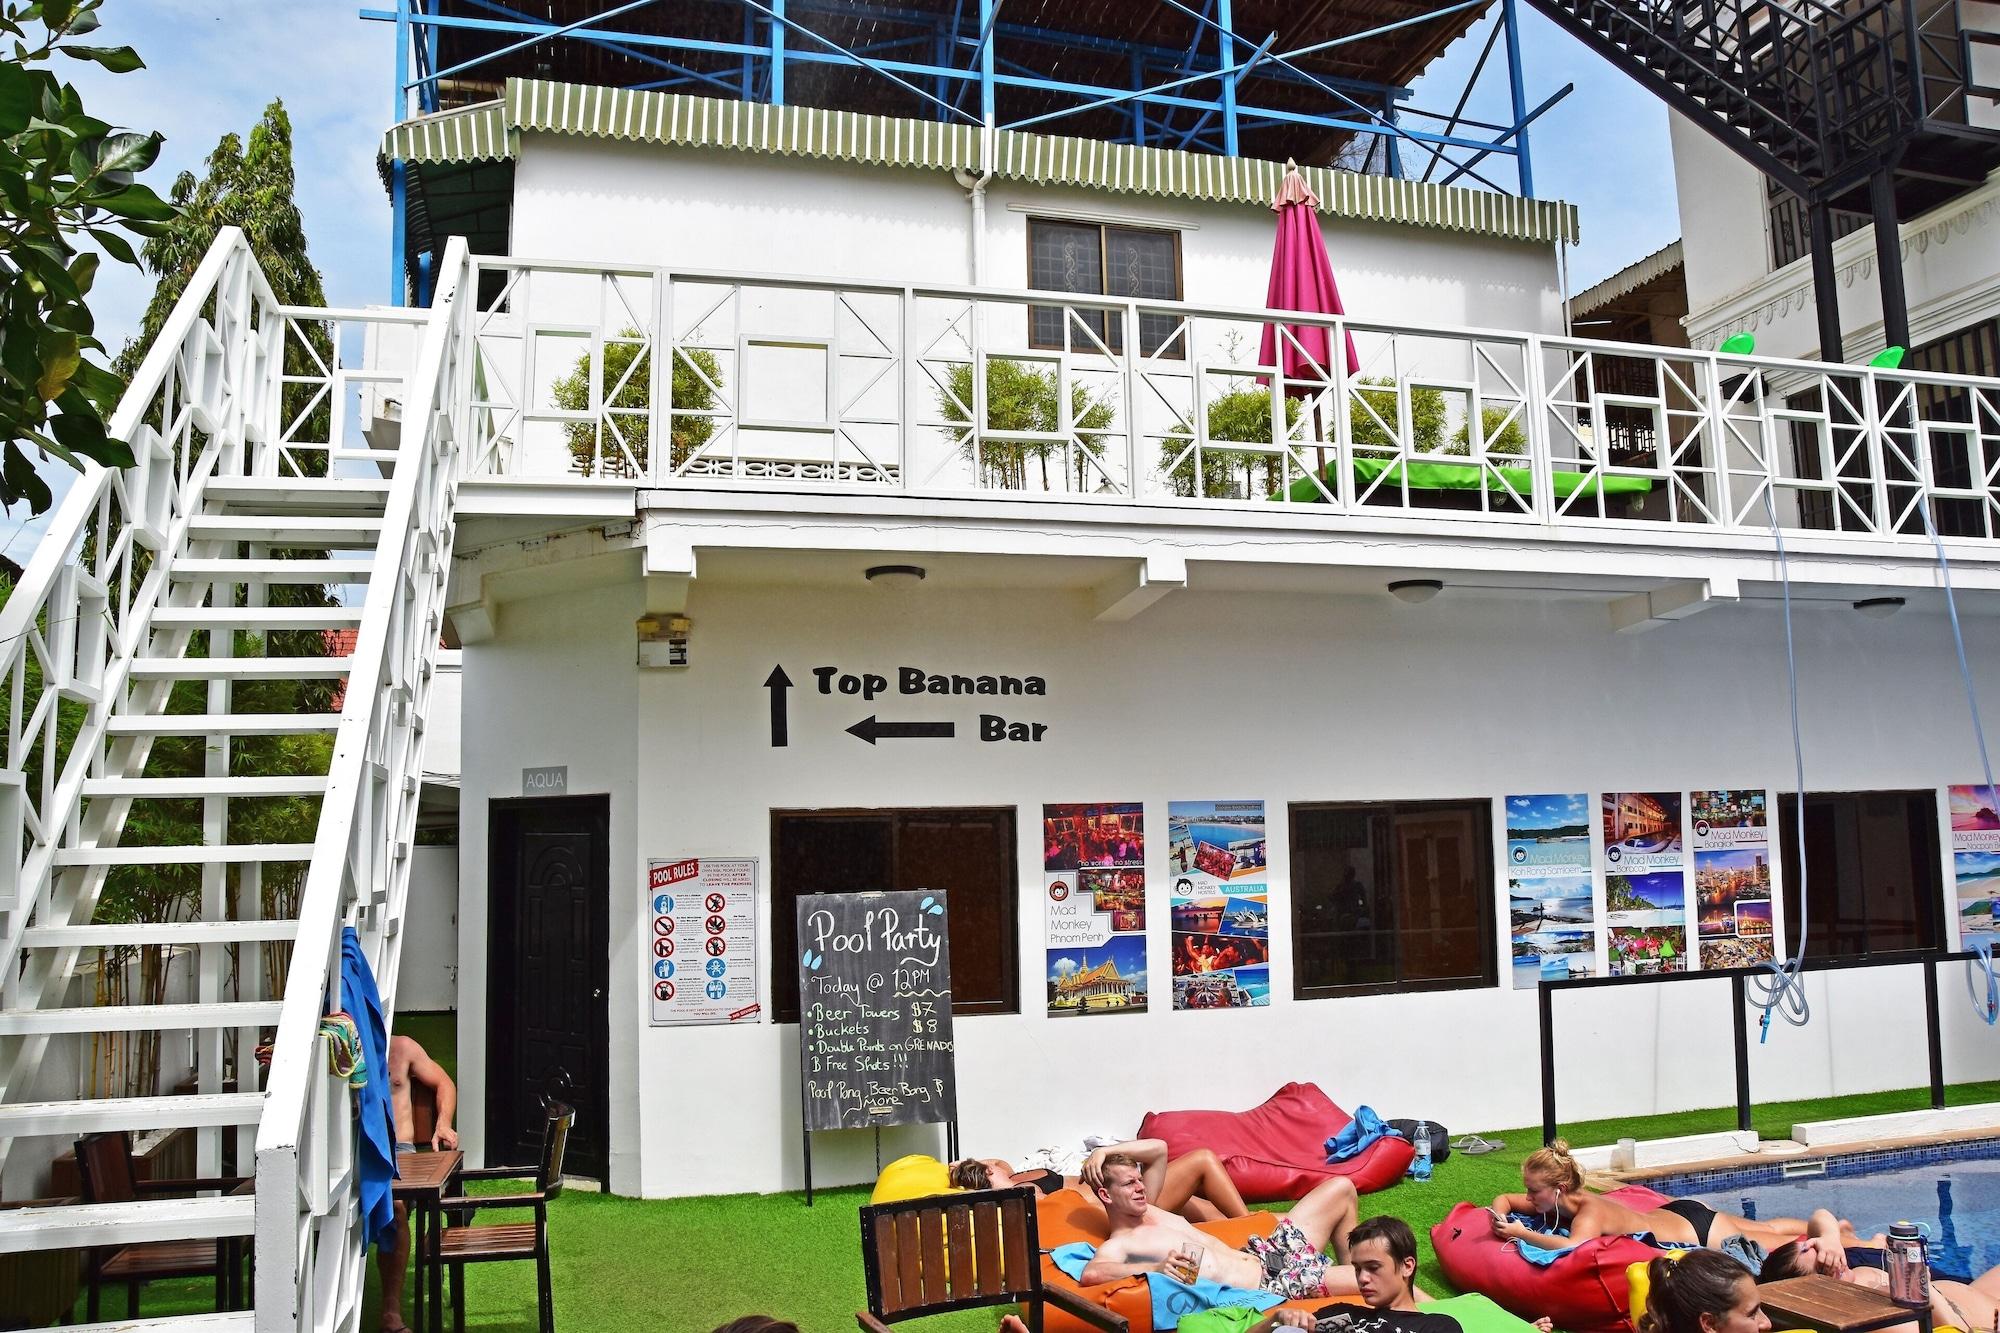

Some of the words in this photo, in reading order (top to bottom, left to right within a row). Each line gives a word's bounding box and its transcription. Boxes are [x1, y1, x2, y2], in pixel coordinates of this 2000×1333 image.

[812, 666, 888, 700] Top
[898, 666, 1046, 696] Banana
[979, 713, 1048, 742] Bar
[526, 771, 564, 789] AQUA
[1711, 830, 1731, 840] Mad
[1732, 829, 1764, 841] Monkey
[1954, 832, 1973, 842] Mad
[1704, 840, 1735, 849] Bangkok
[1623, 855, 1645, 865] Mad
[1646, 854, 1679, 866] Monkey
[653, 869, 673, 885] POOL
[673, 862, 695, 880] RULES
[1225, 885, 1265, 893] AUSTRALIA
[1050, 905, 1077, 916] Mad
[1050, 919, 1092, 931] Monkey
[807, 910, 875, 953] Pool
[877, 907, 942, 967] Party
[1050, 933, 1081, 943] Phnom
[1081, 932, 1104, 942] Penh
[811, 974, 860, 1008] Today
[866, 972, 884, 994] @
[811, 1002, 852, 1022] Beer
[860, 1004, 900, 1021] Towers
[814, 1021, 870, 1039] Buckets
[816, 1039, 855, 1055] Double
[857, 1037, 886, 1052] Points
[889, 1043, 903, 1052] on
[826, 1055, 848, 1072] Free
[808, 1080, 834, 1100] Pool
[866, 1080, 899, 1096] Beer
[897, 1081, 931, 1103] Bong
